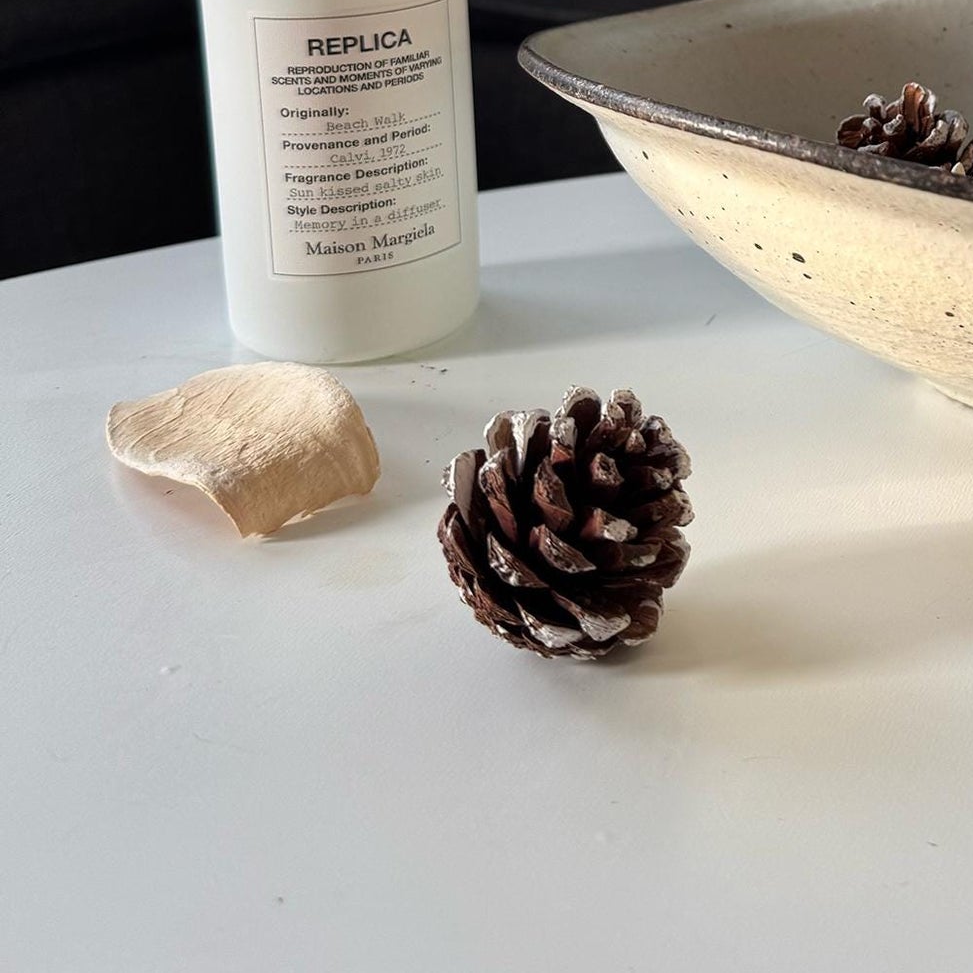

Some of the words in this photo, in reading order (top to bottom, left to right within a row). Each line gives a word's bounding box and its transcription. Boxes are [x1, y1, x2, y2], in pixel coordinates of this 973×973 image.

[307, 29, 412, 56] REPLICA
[272, 77, 311, 85] SCENTS
[314, 75, 336, 85] AND
[339, 69, 392, 83] MOMENTS
[395, 67, 407, 75] OF
[409, 56, 442, 72] VARYING
[288, 62, 372, 75] REPRODUCTION
[376, 59, 389, 69] OF
[390, 51, 430, 66] FAMILIAR
[298, 83, 358, 95] LOCATIONS
[360, 81, 382, 91] AND
[385, 72, 424, 87] PERIODS
[281, 107, 349, 120] Originally:
[327, 119, 368, 131] Beach
[374, 112, 406, 126] Walk
[283, 139, 359, 150] Provenance
[364, 133, 387, 146] and
[392, 124, 431, 139] Period:
[381, 144, 406, 157] 1972
[285, 173, 350, 184] Fragrance
[356, 157, 428, 179] Description:
[290, 188, 313, 197] Sun
[320, 183, 369, 197] kissed
[375, 176, 411, 191] salty
[416, 167, 441, 182] skin
[288, 205, 317, 216] Style
[321, 197, 396, 214] Description:
[294, 219, 346, 230] Memory
[352, 216, 368, 226] in
[374, 215, 381, 223] a
[388, 198, 441, 219] diffuser
[305, 241, 365, 255] Maison
[372, 222, 435, 249] Margiela
[358, 252, 394, 264] PARIS
